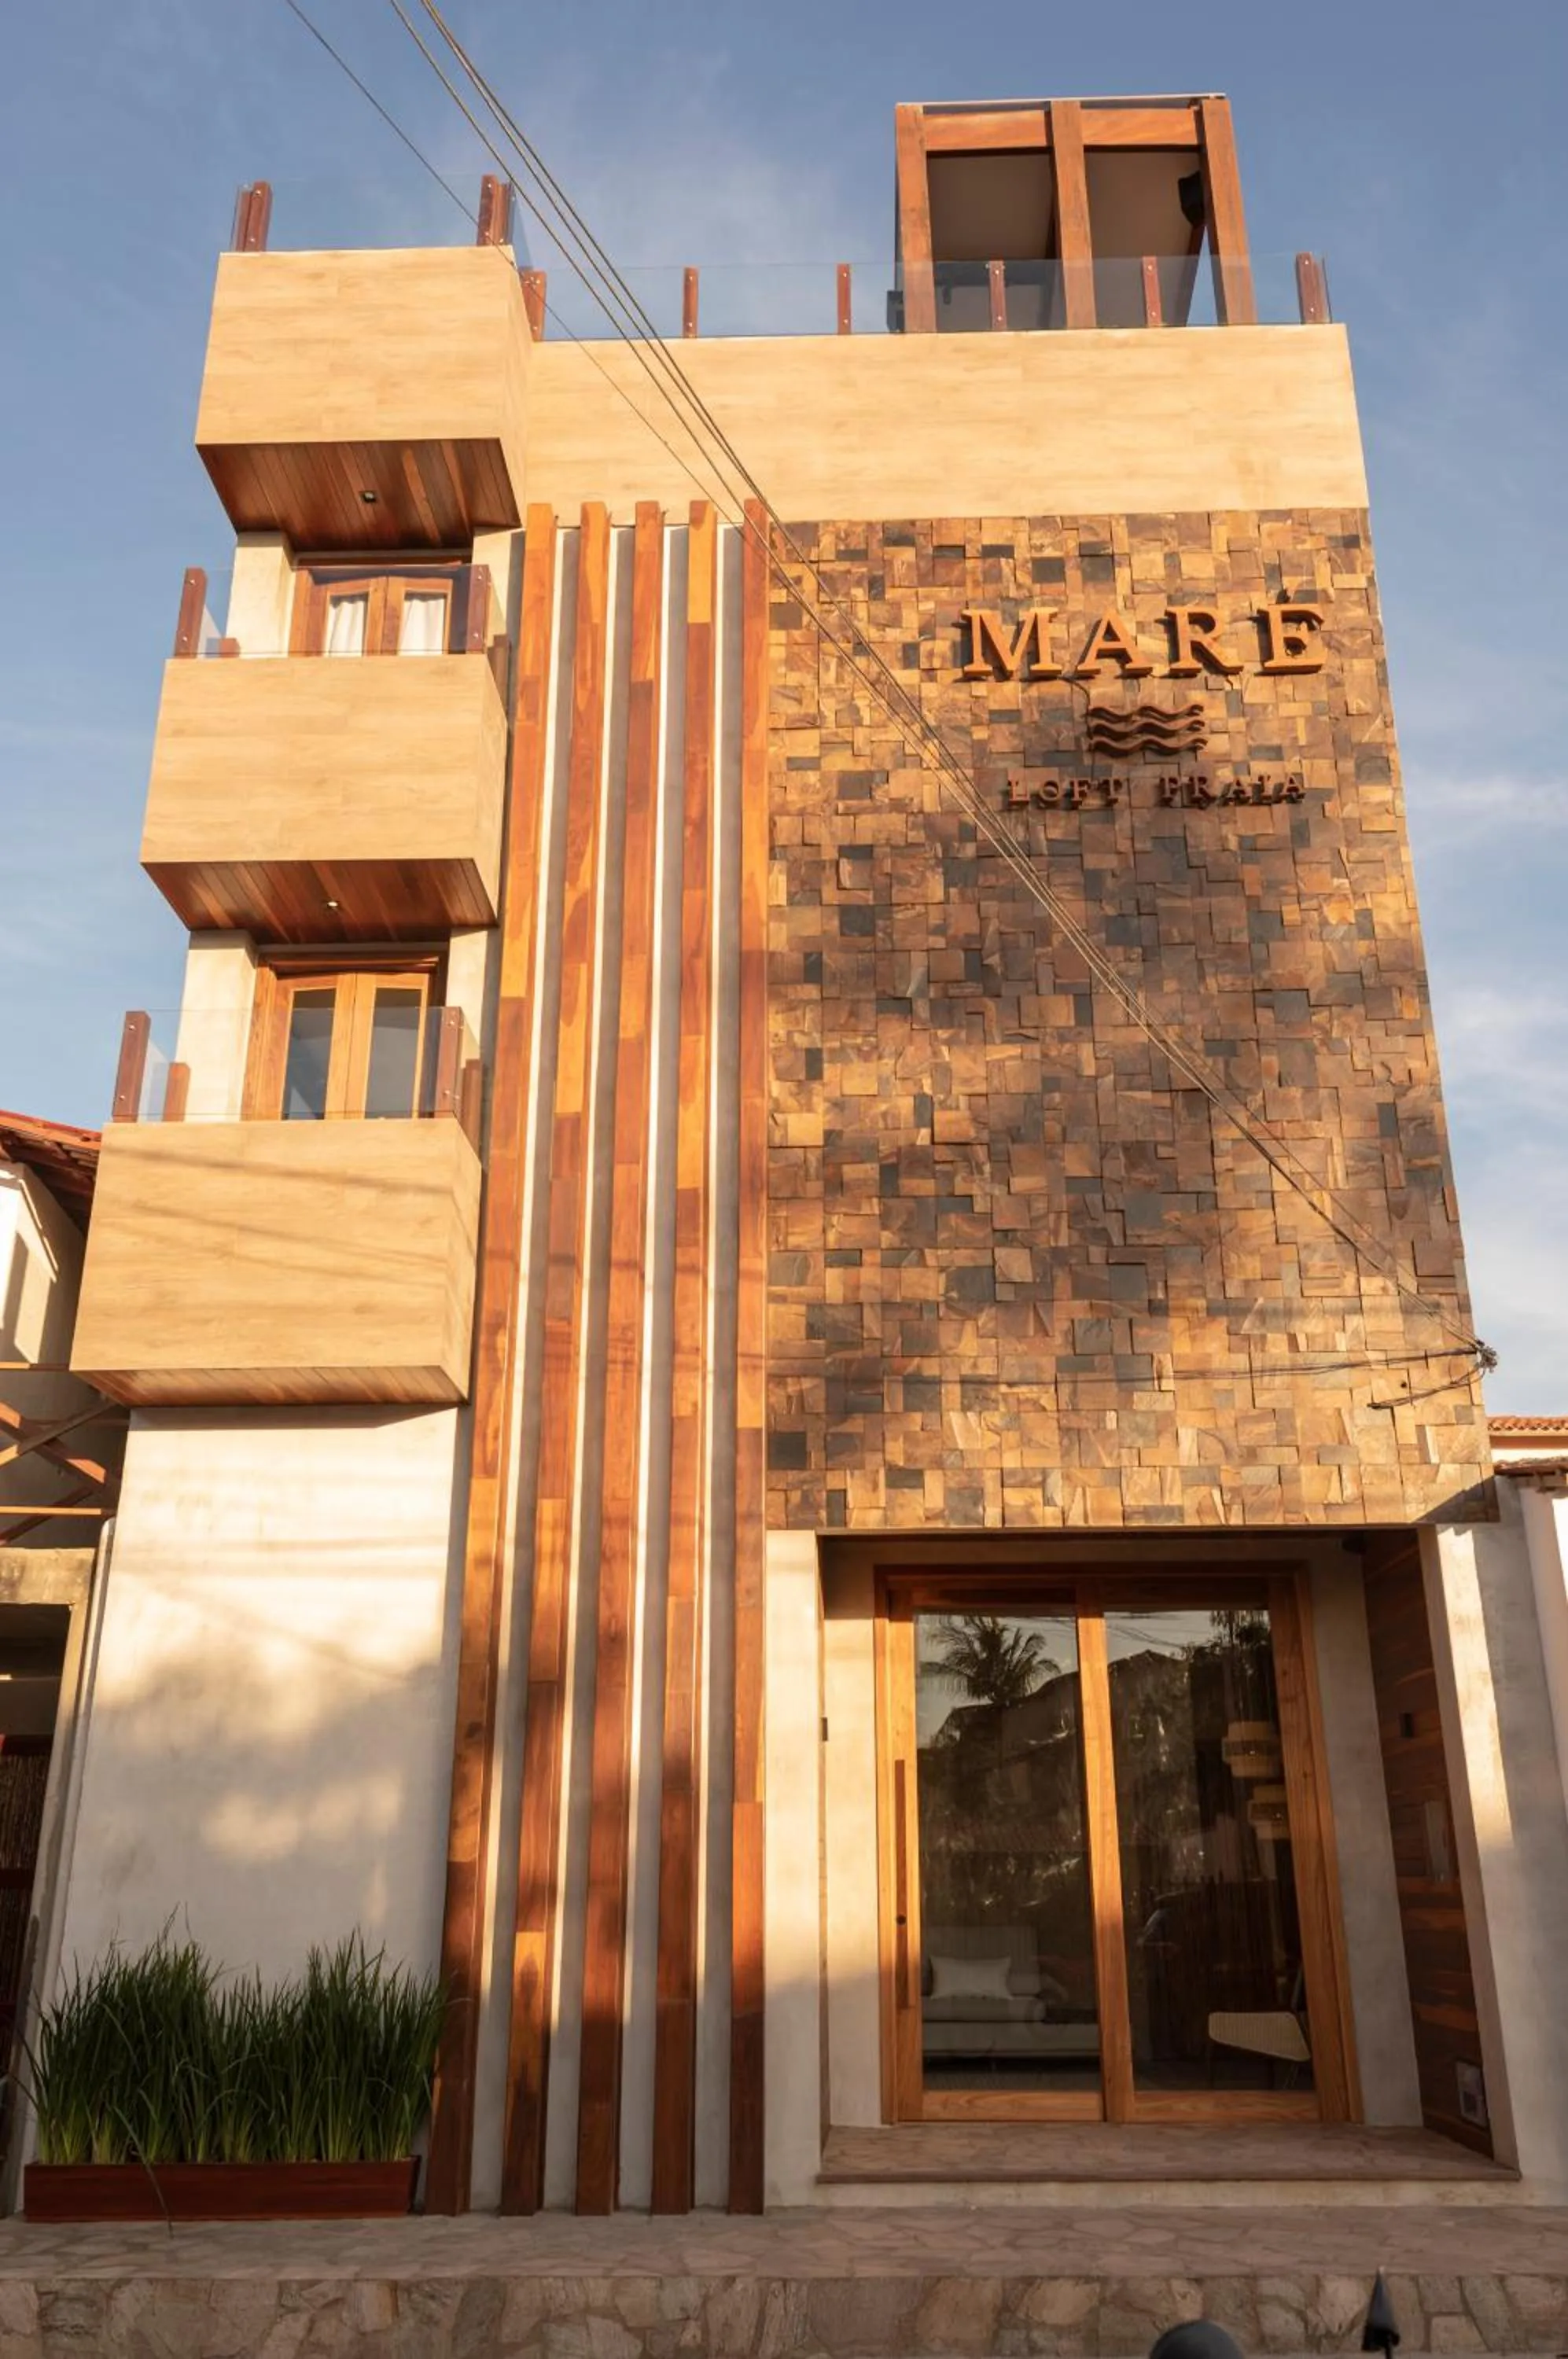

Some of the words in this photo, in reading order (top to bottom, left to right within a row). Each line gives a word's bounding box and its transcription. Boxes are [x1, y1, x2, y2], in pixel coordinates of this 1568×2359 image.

[960, 604, 1327, 678] MARE
[1007, 776, 1124, 807] LOFT
[1159, 774, 1305, 807] PRAIA
